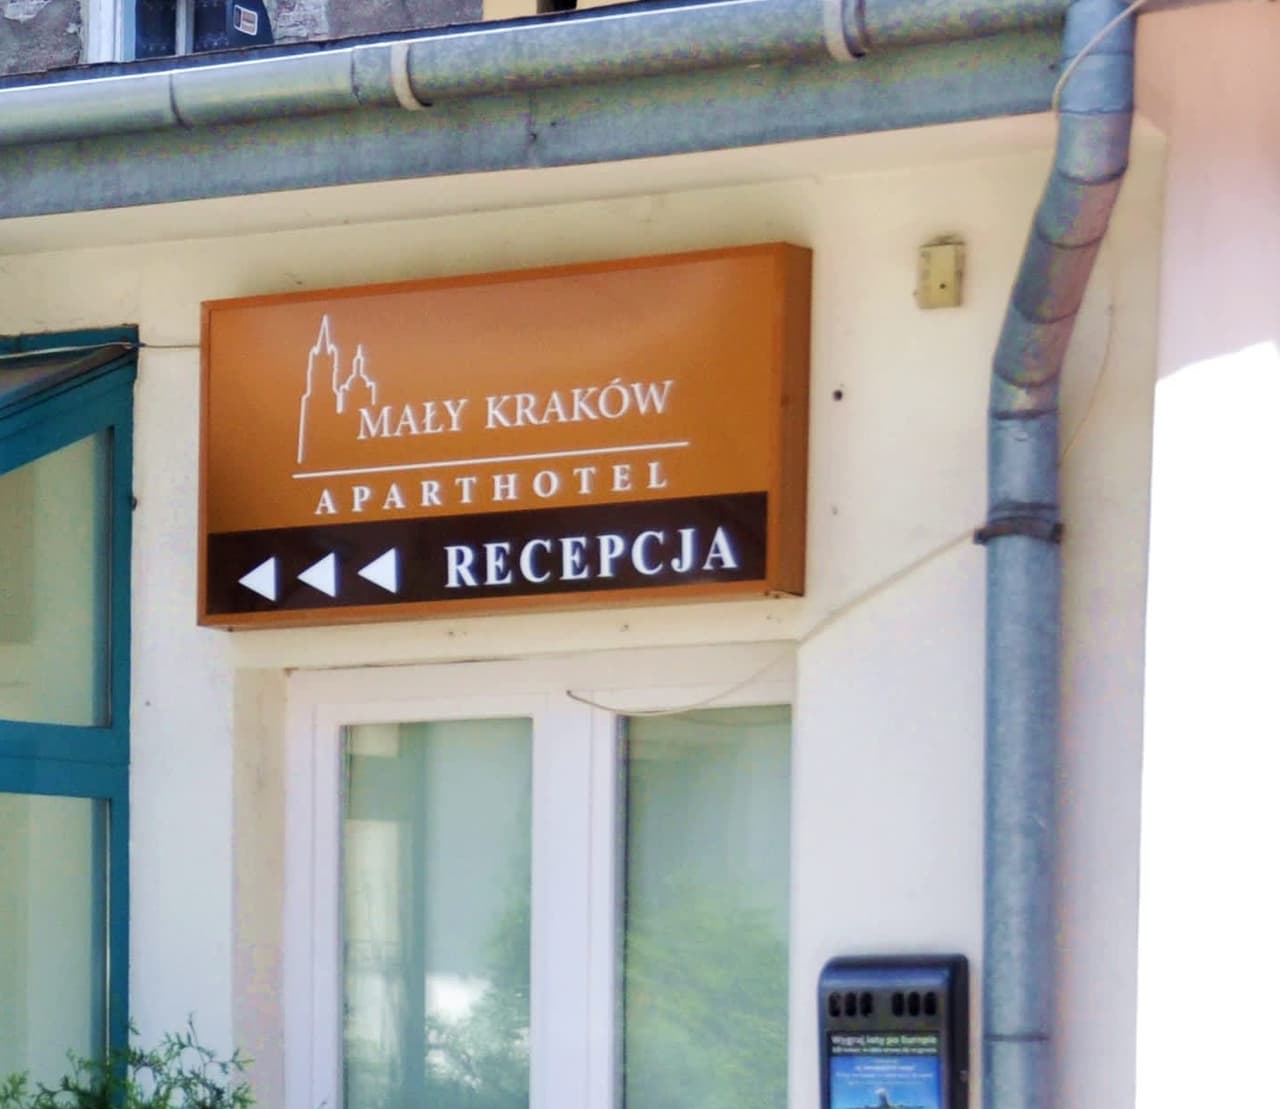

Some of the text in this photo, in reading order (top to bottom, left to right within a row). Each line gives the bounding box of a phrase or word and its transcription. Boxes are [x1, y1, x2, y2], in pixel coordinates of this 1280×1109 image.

[356, 378, 673, 440] MAŁY KRAKÓW
[314, 461, 668, 516] APARTHOTEL
[443, 525, 738, 588] RECEPCJA
